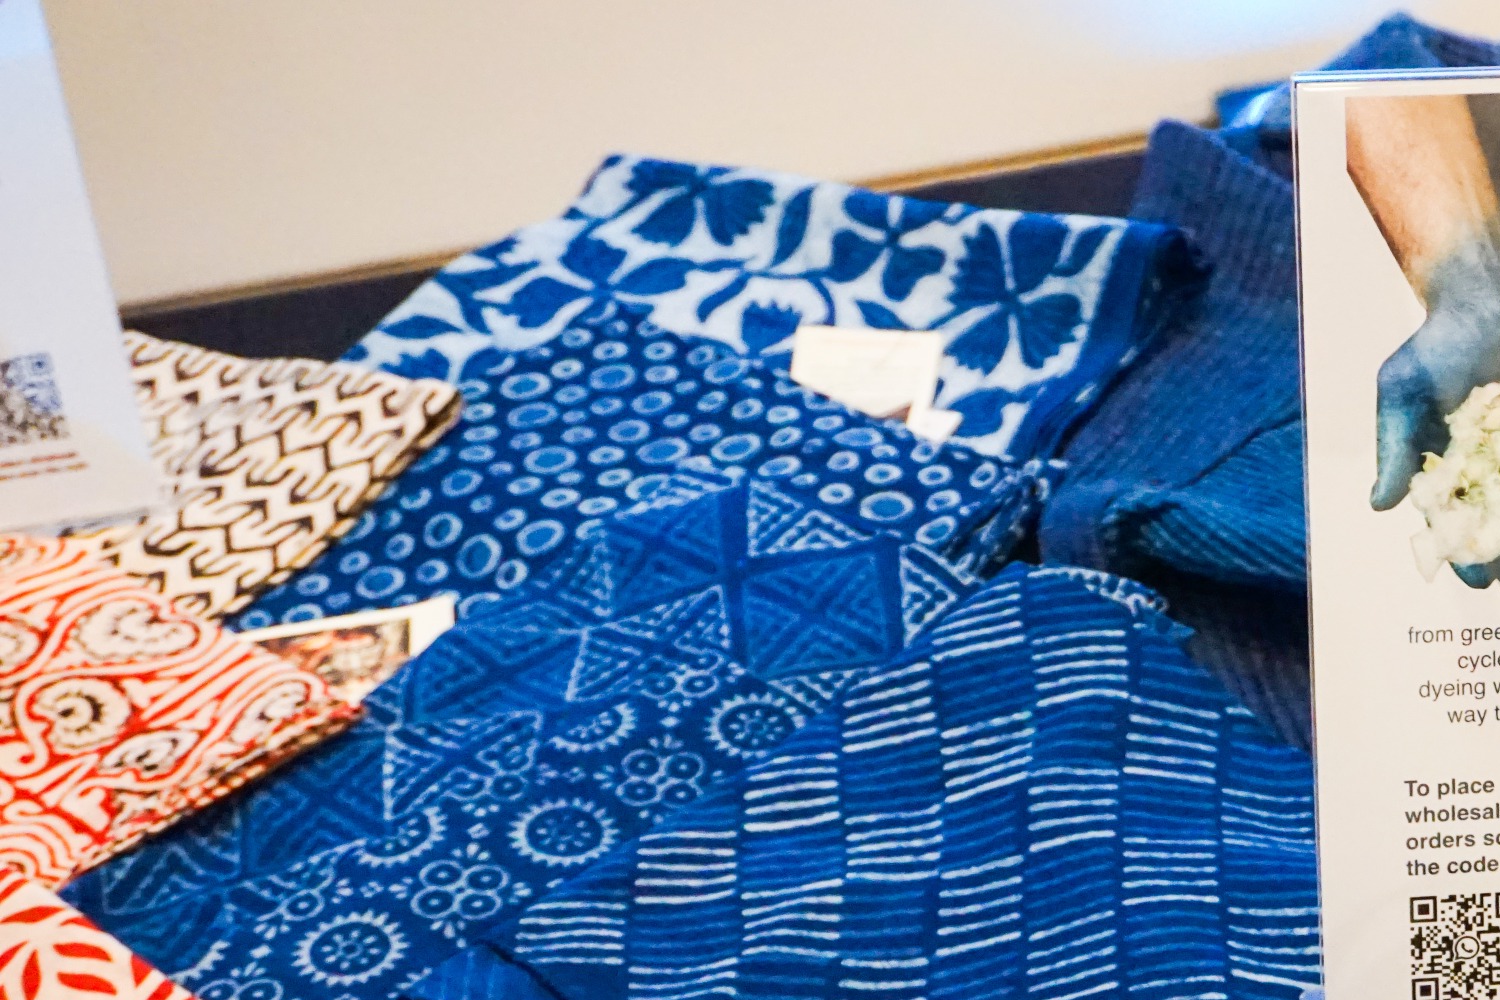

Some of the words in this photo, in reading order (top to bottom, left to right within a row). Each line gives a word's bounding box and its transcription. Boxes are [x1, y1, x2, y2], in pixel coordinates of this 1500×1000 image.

[1408, 626, 1454, 644] from
[1418, 678, 1486, 702] dyeing
[1447, 709, 1488, 727] way
[1403, 779, 1430, 797] To
[1437, 778, 1496, 801] place
[1405, 831, 1476, 851] orders
[1405, 859, 1440, 877] the
[1446, 855, 1499, 875] code
